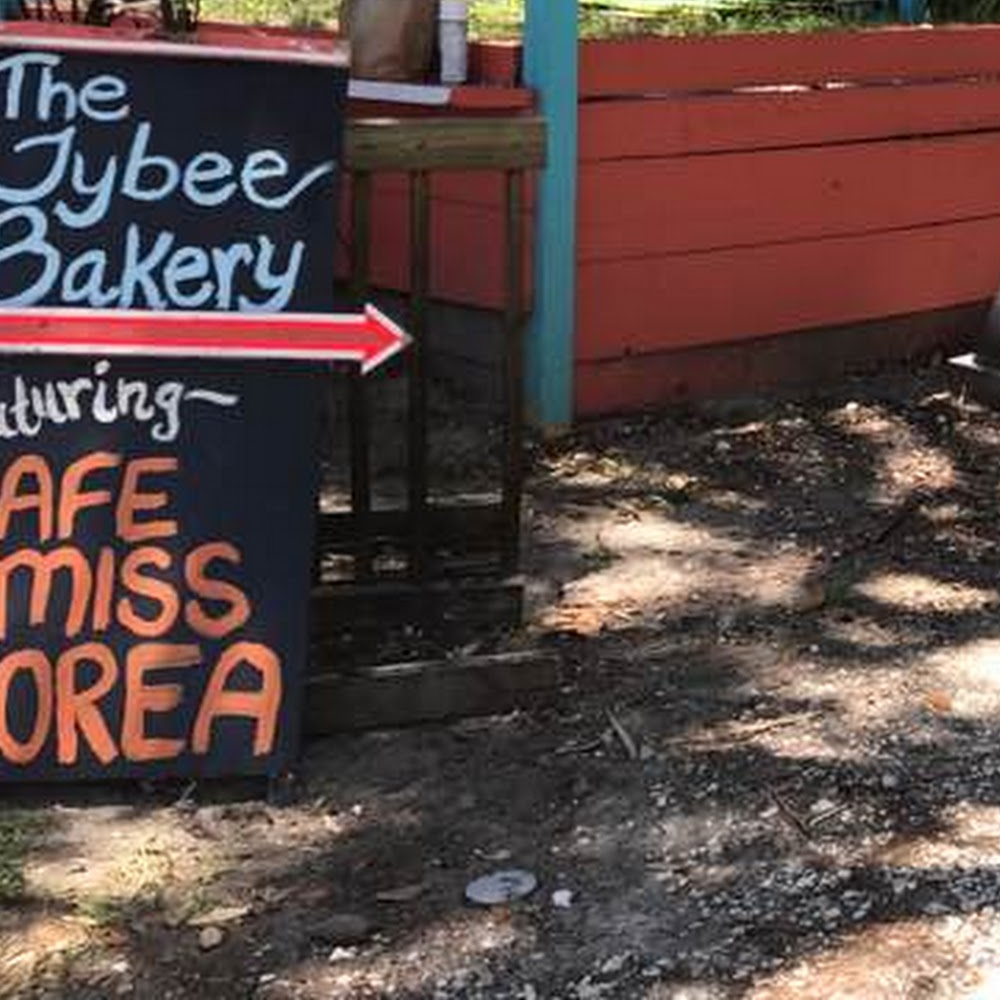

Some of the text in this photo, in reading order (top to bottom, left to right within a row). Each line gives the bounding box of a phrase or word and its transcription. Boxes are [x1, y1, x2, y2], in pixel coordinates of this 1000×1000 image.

[0, 53, 130, 121] The
[0, 122, 336, 228] Tybee
[0, 223, 304, 312] Bakery
[0, 541, 251, 638] MISS
